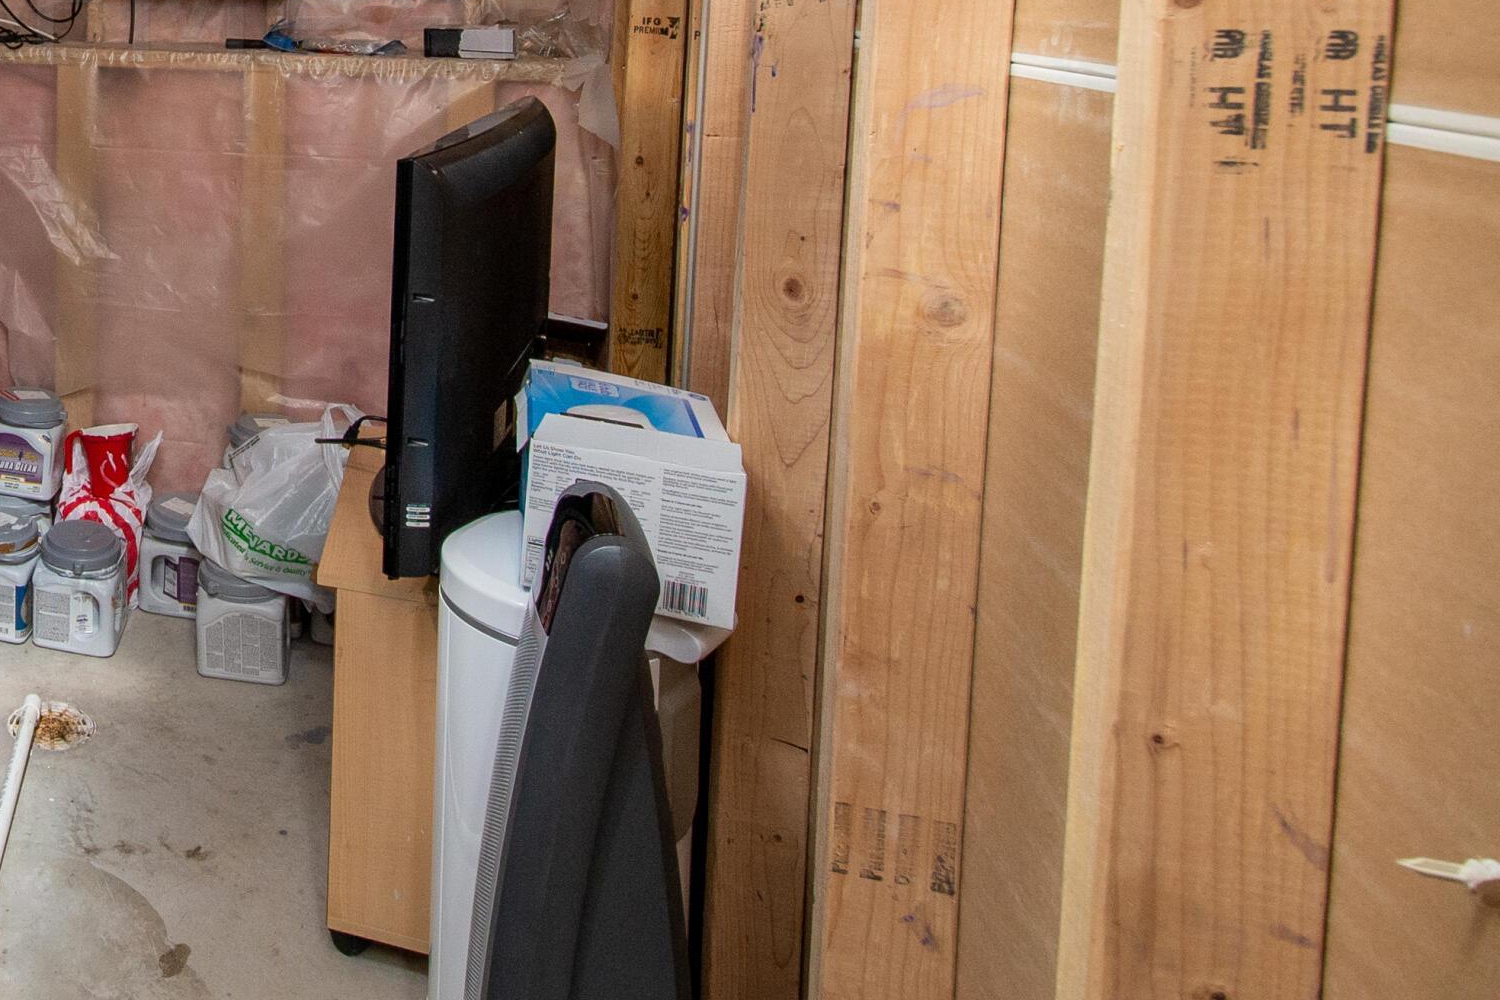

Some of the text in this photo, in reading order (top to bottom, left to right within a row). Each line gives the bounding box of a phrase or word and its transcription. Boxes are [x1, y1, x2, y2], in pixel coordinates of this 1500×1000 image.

[633, 26, 669, 36] PREMIUM
[642, 16, 661, 26] IFG
[1208, 86, 1246, 136] HT
[1320, 88, 1359, 139] HT
